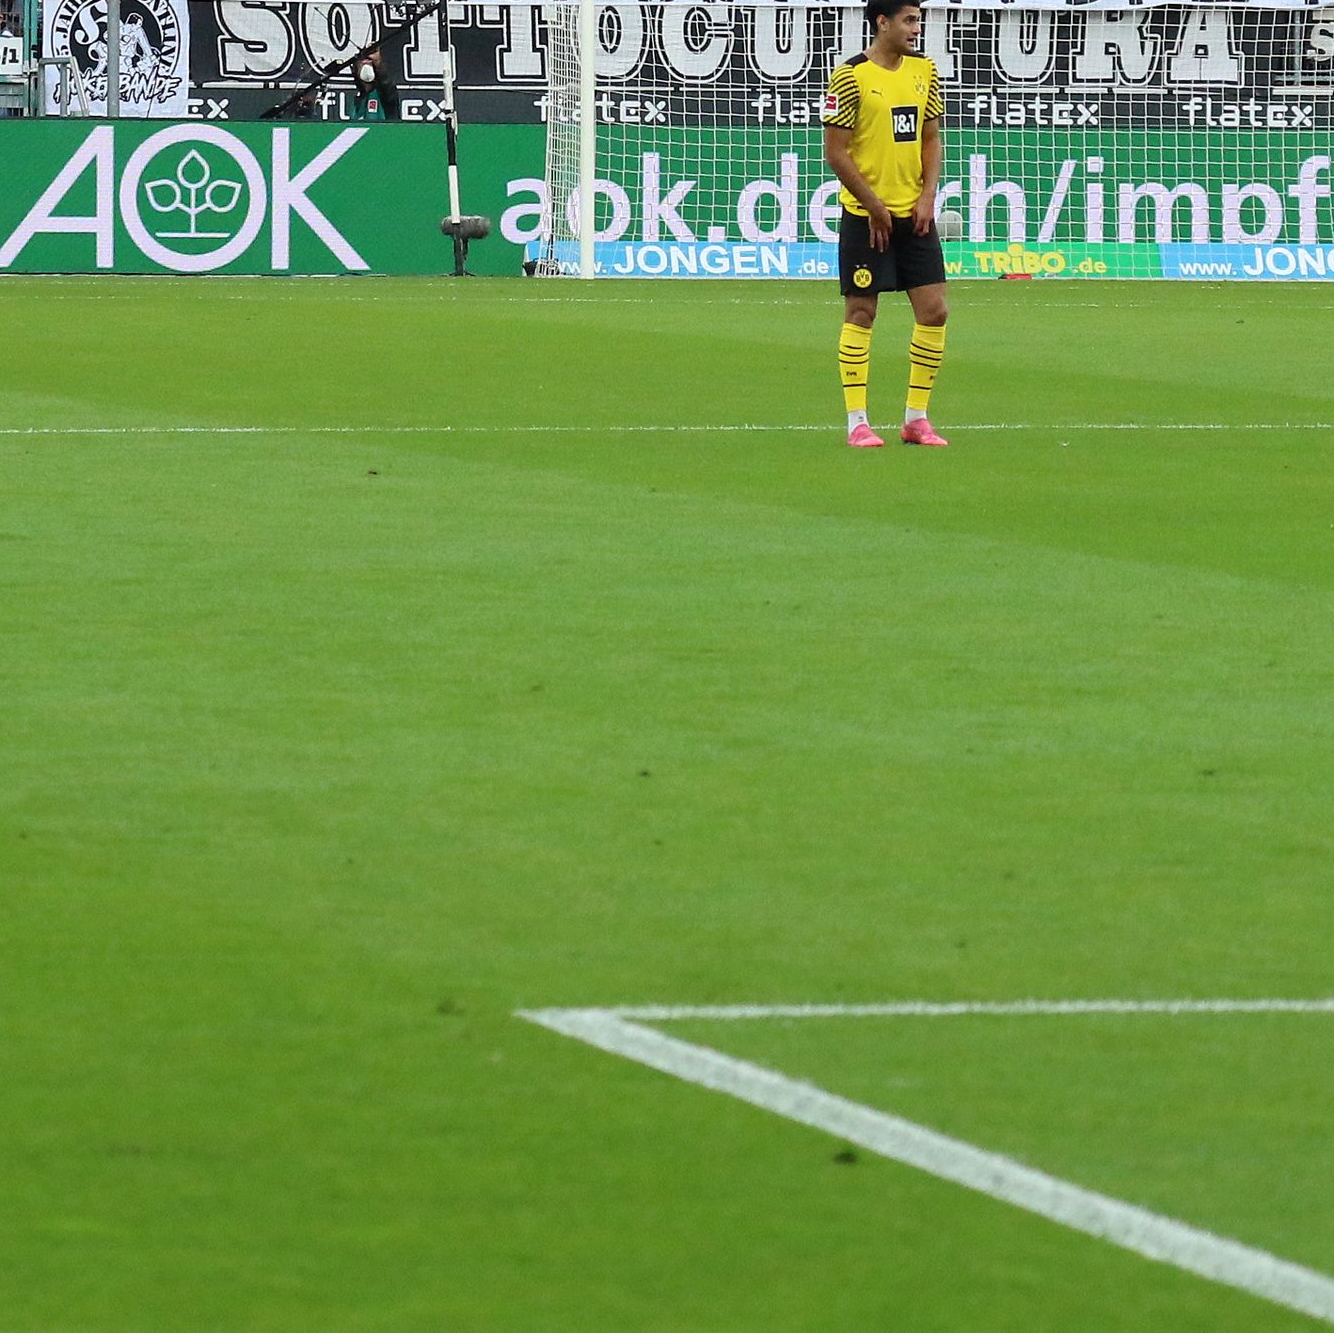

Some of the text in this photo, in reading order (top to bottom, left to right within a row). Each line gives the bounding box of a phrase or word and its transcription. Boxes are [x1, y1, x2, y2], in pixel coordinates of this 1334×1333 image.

[317, 92, 448, 121] flex
[751, 93, 825, 123] flat
[968, 94, 1099, 125] flatex
[1182, 97, 1313, 128] flatex
[892, 115, 917, 135] 1&1
[615, 245, 789, 275] JONGEN
[801, 257, 830, 276] .de
[1179, 261, 1235, 278] www.
